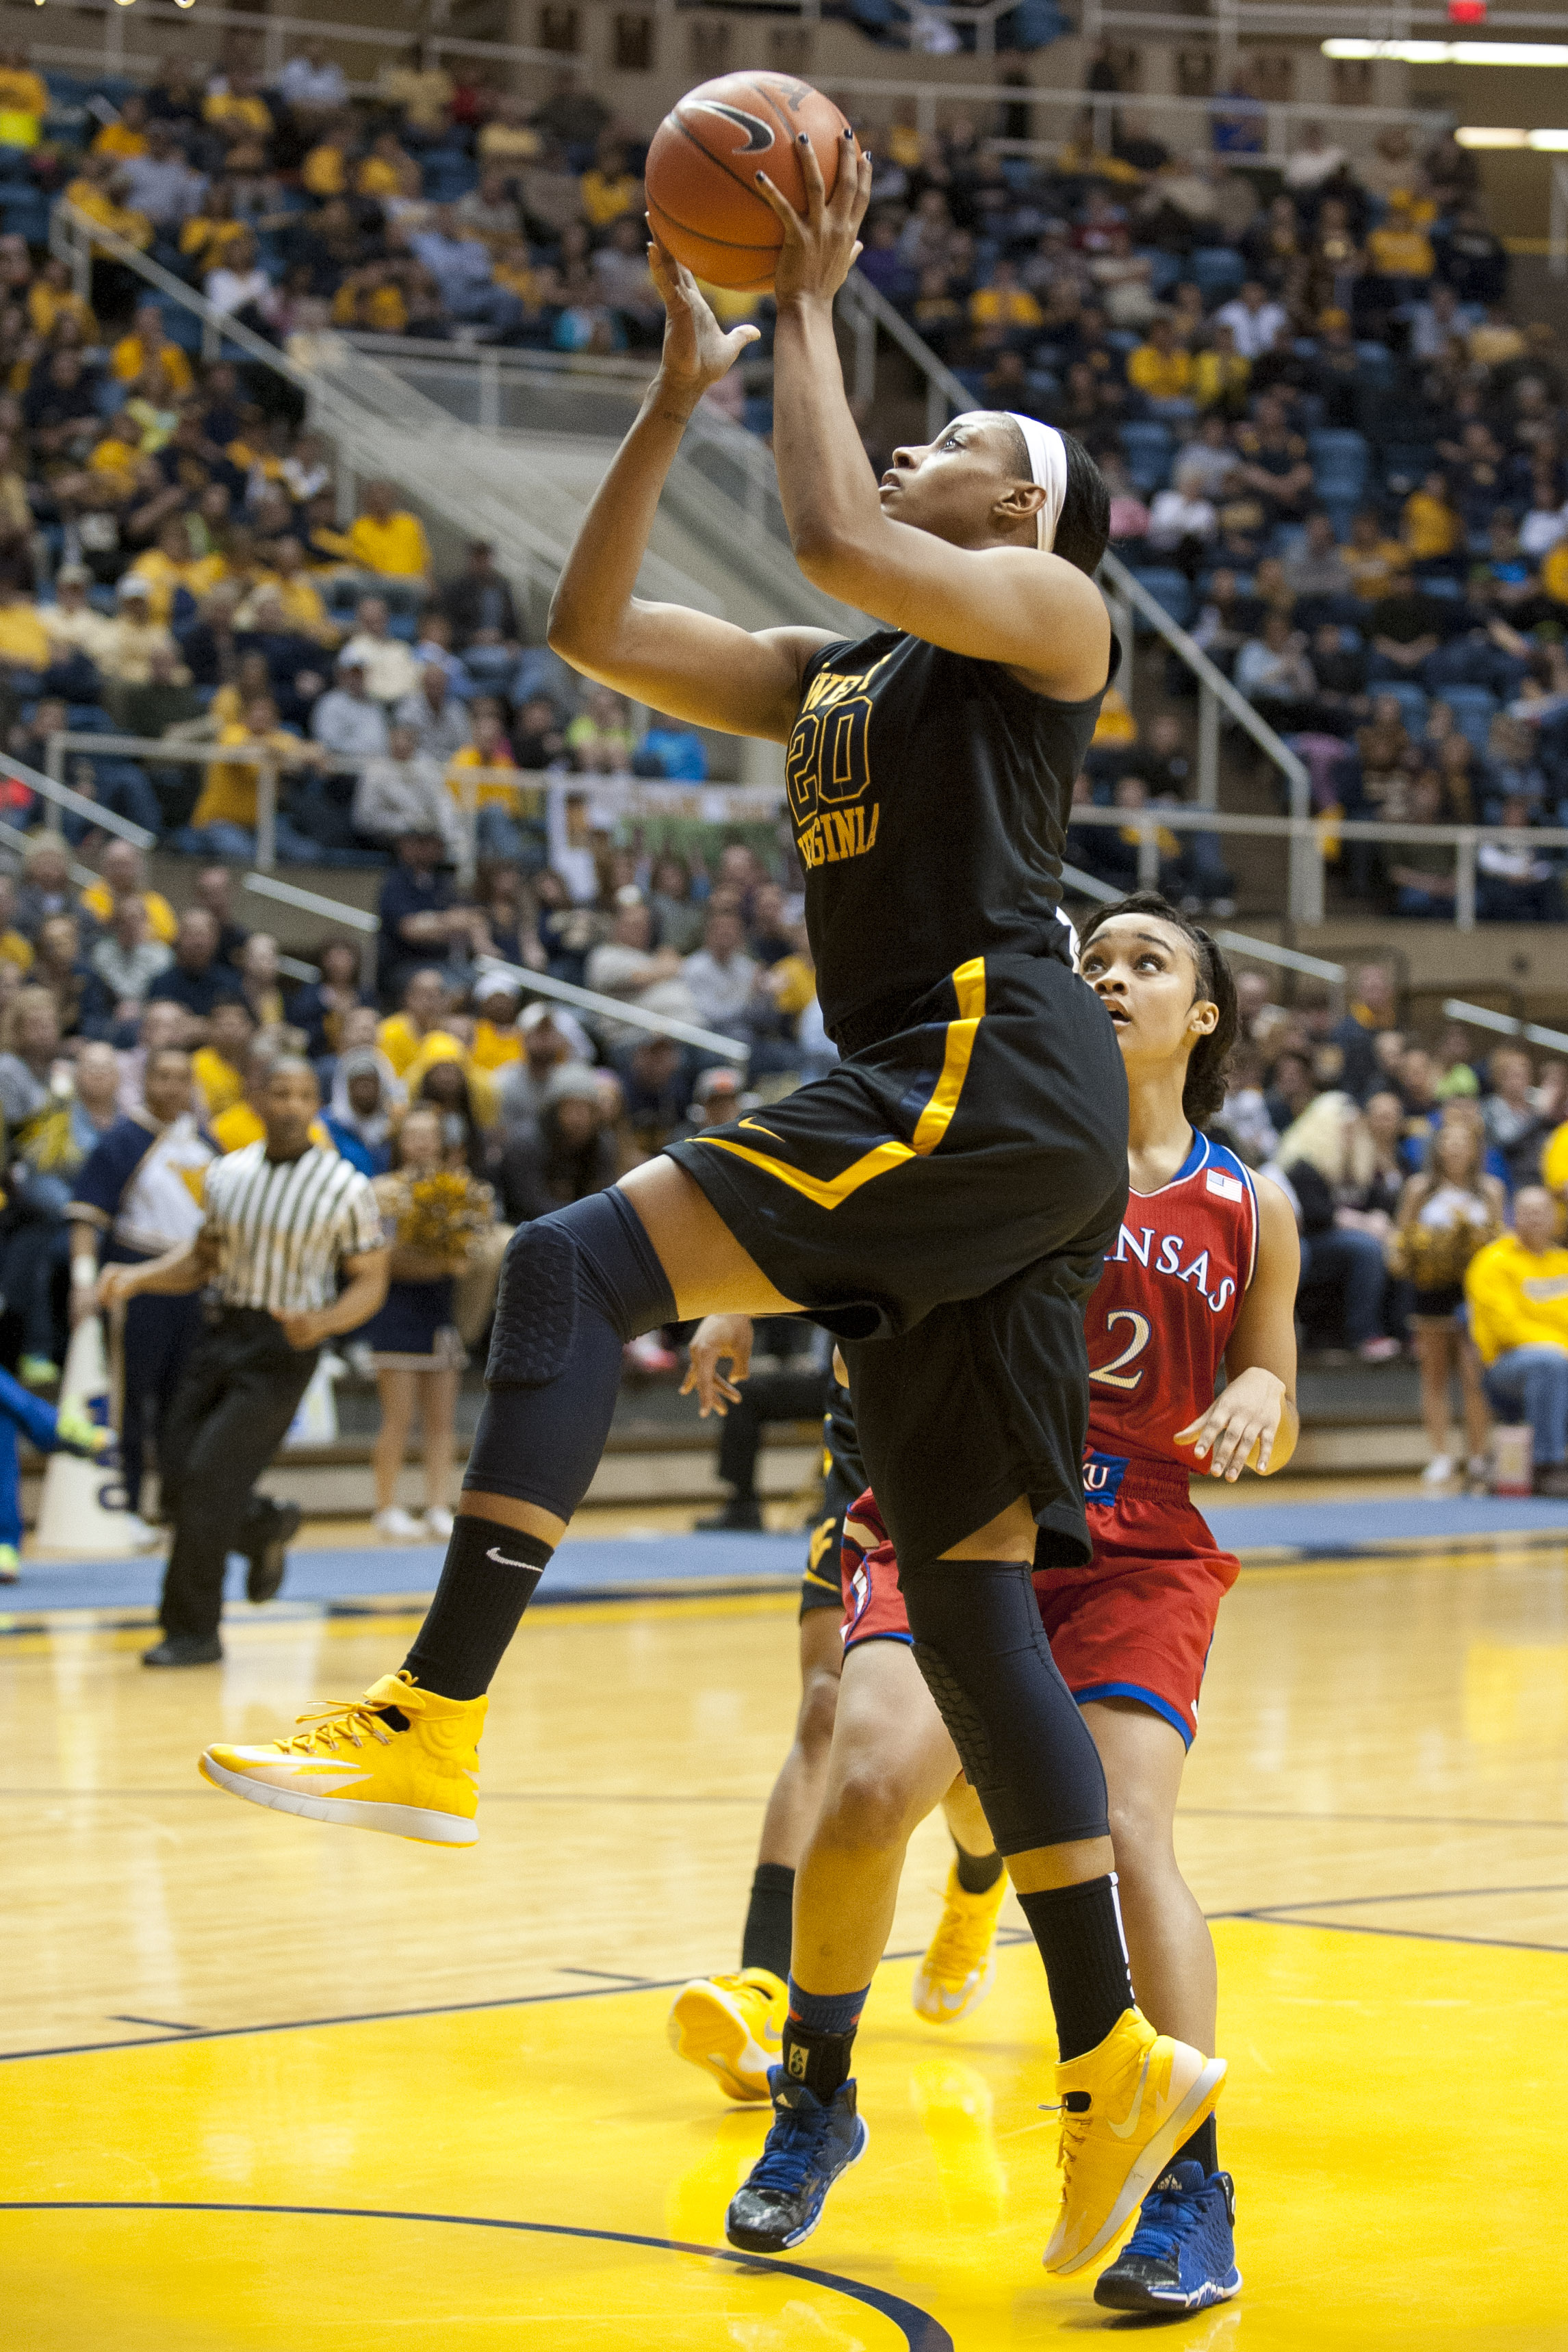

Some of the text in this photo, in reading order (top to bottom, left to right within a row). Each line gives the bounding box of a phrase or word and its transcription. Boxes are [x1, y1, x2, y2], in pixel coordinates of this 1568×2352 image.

[786, 695, 873, 827] 20
[1103, 1223, 1236, 1313] NSAS
[1088, 1309, 1152, 1390] 2
